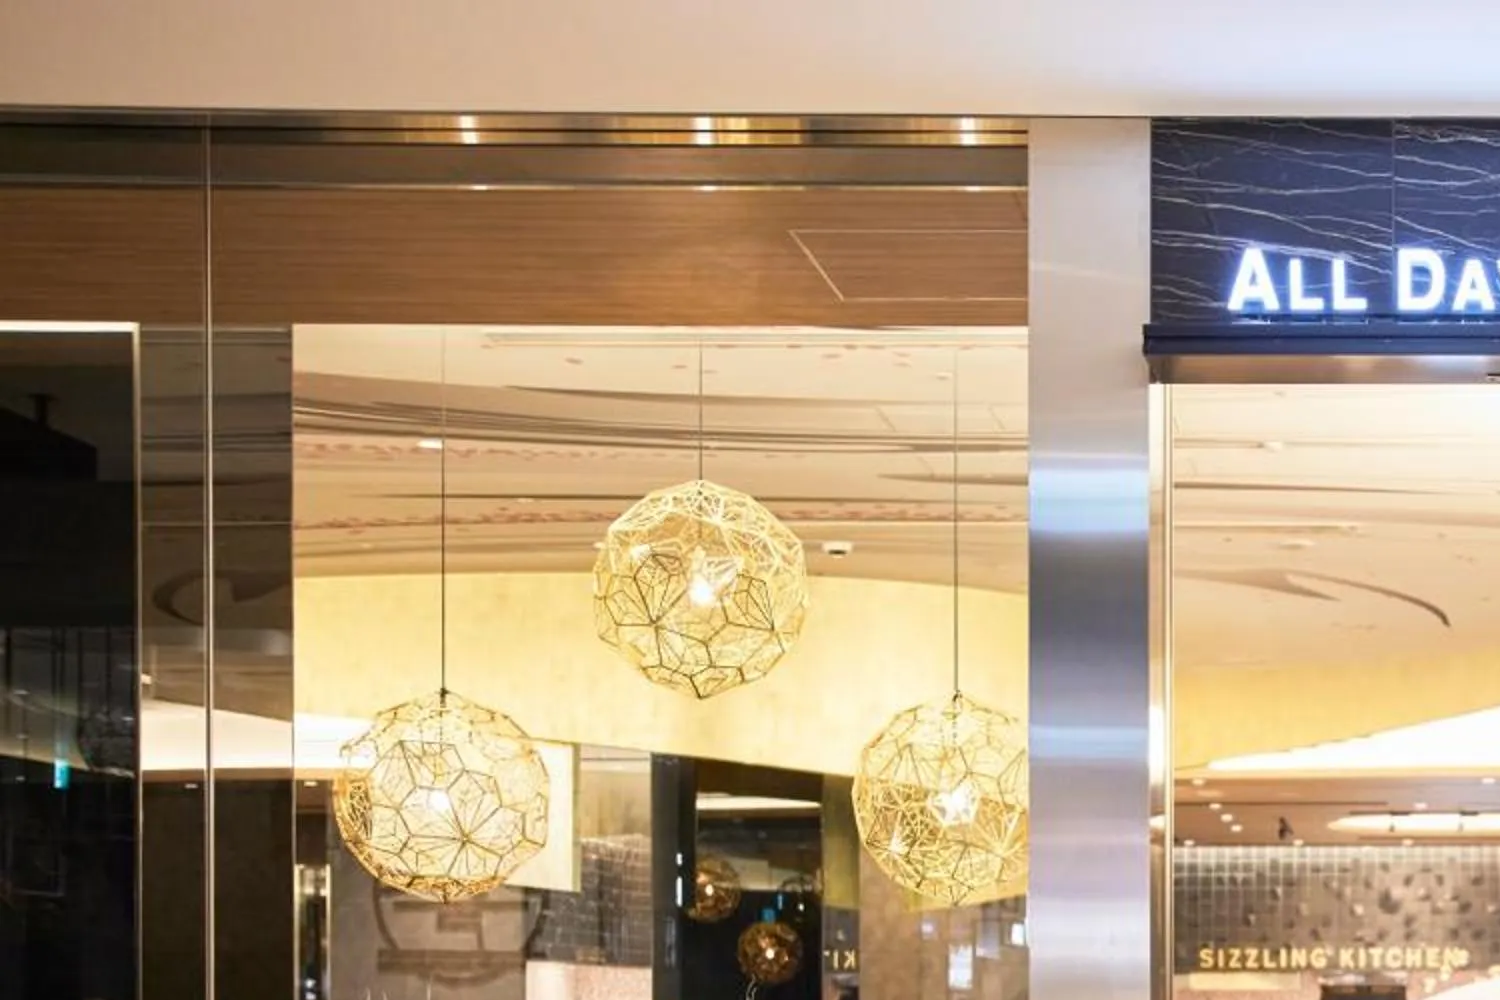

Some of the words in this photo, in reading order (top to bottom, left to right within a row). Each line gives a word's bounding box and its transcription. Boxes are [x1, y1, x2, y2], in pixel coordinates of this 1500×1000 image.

[1227, 248, 1367, 312] ALL
[1199, 947, 1330, 969] SIZZLING
[1339, 947, 1461, 968] KITCHEN
